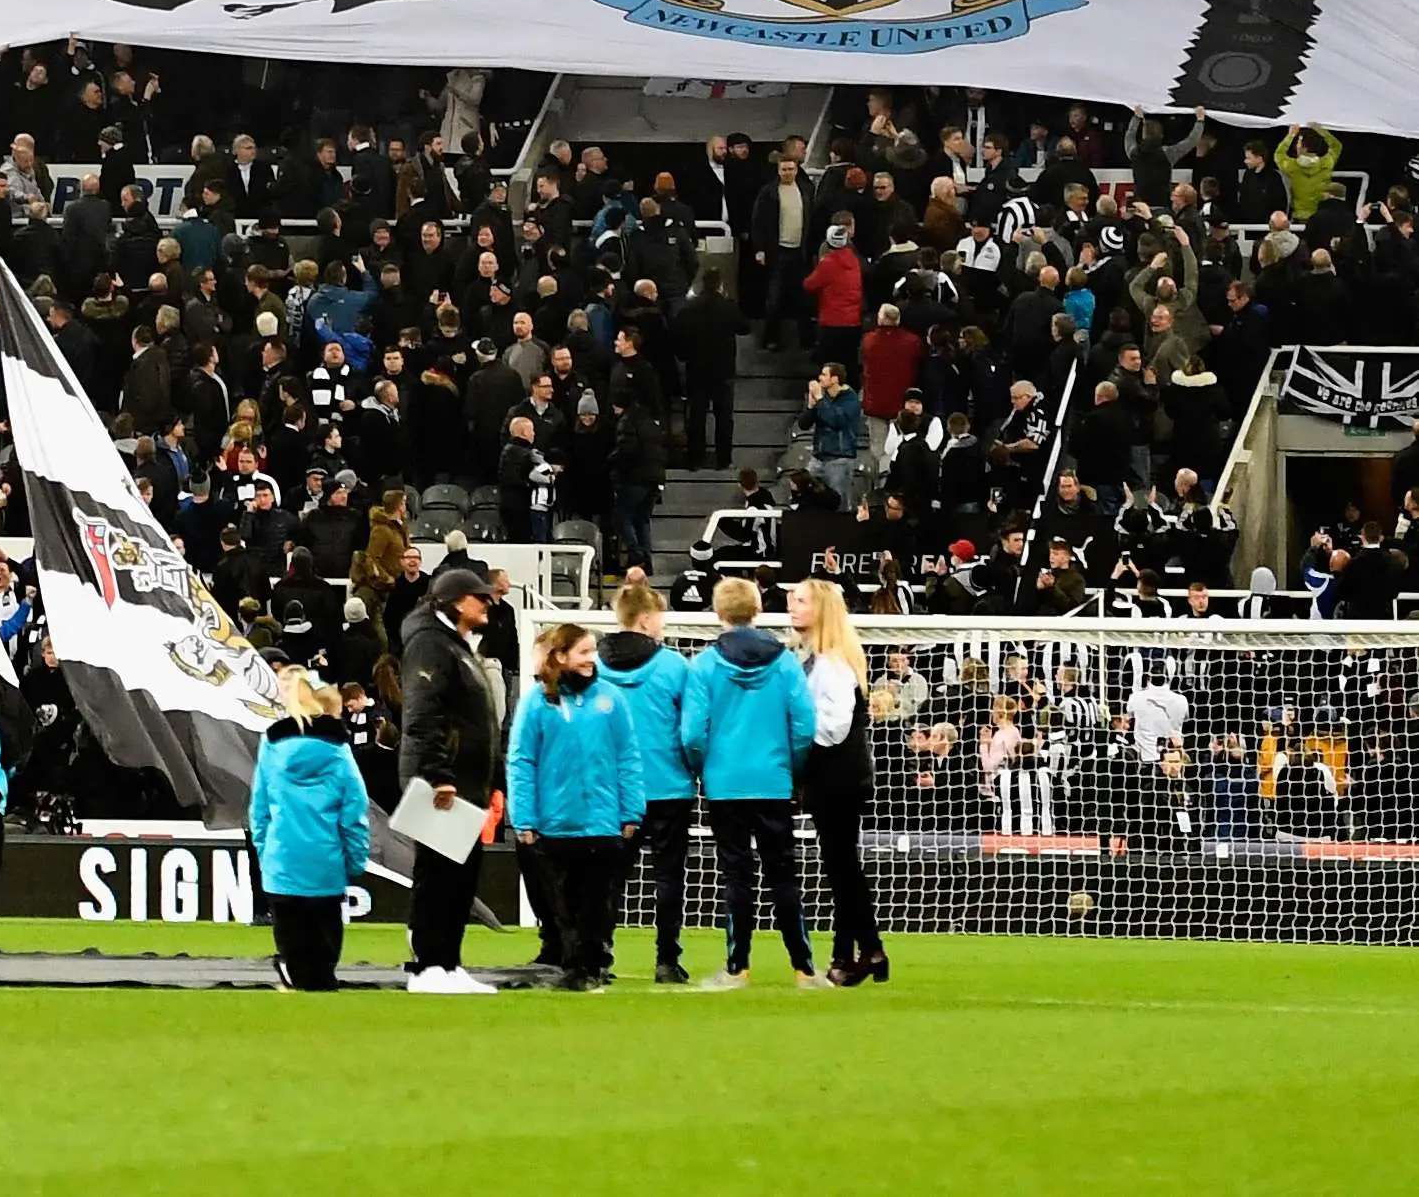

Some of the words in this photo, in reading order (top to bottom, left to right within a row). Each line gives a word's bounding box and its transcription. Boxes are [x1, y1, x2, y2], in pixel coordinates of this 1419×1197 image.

[643, 7, 862, 48] NEWCASTLE
[870, 14, 1013, 49] UNITED
[811, 551, 919, 575] FORE
[77, 845, 255, 925] SIGN
